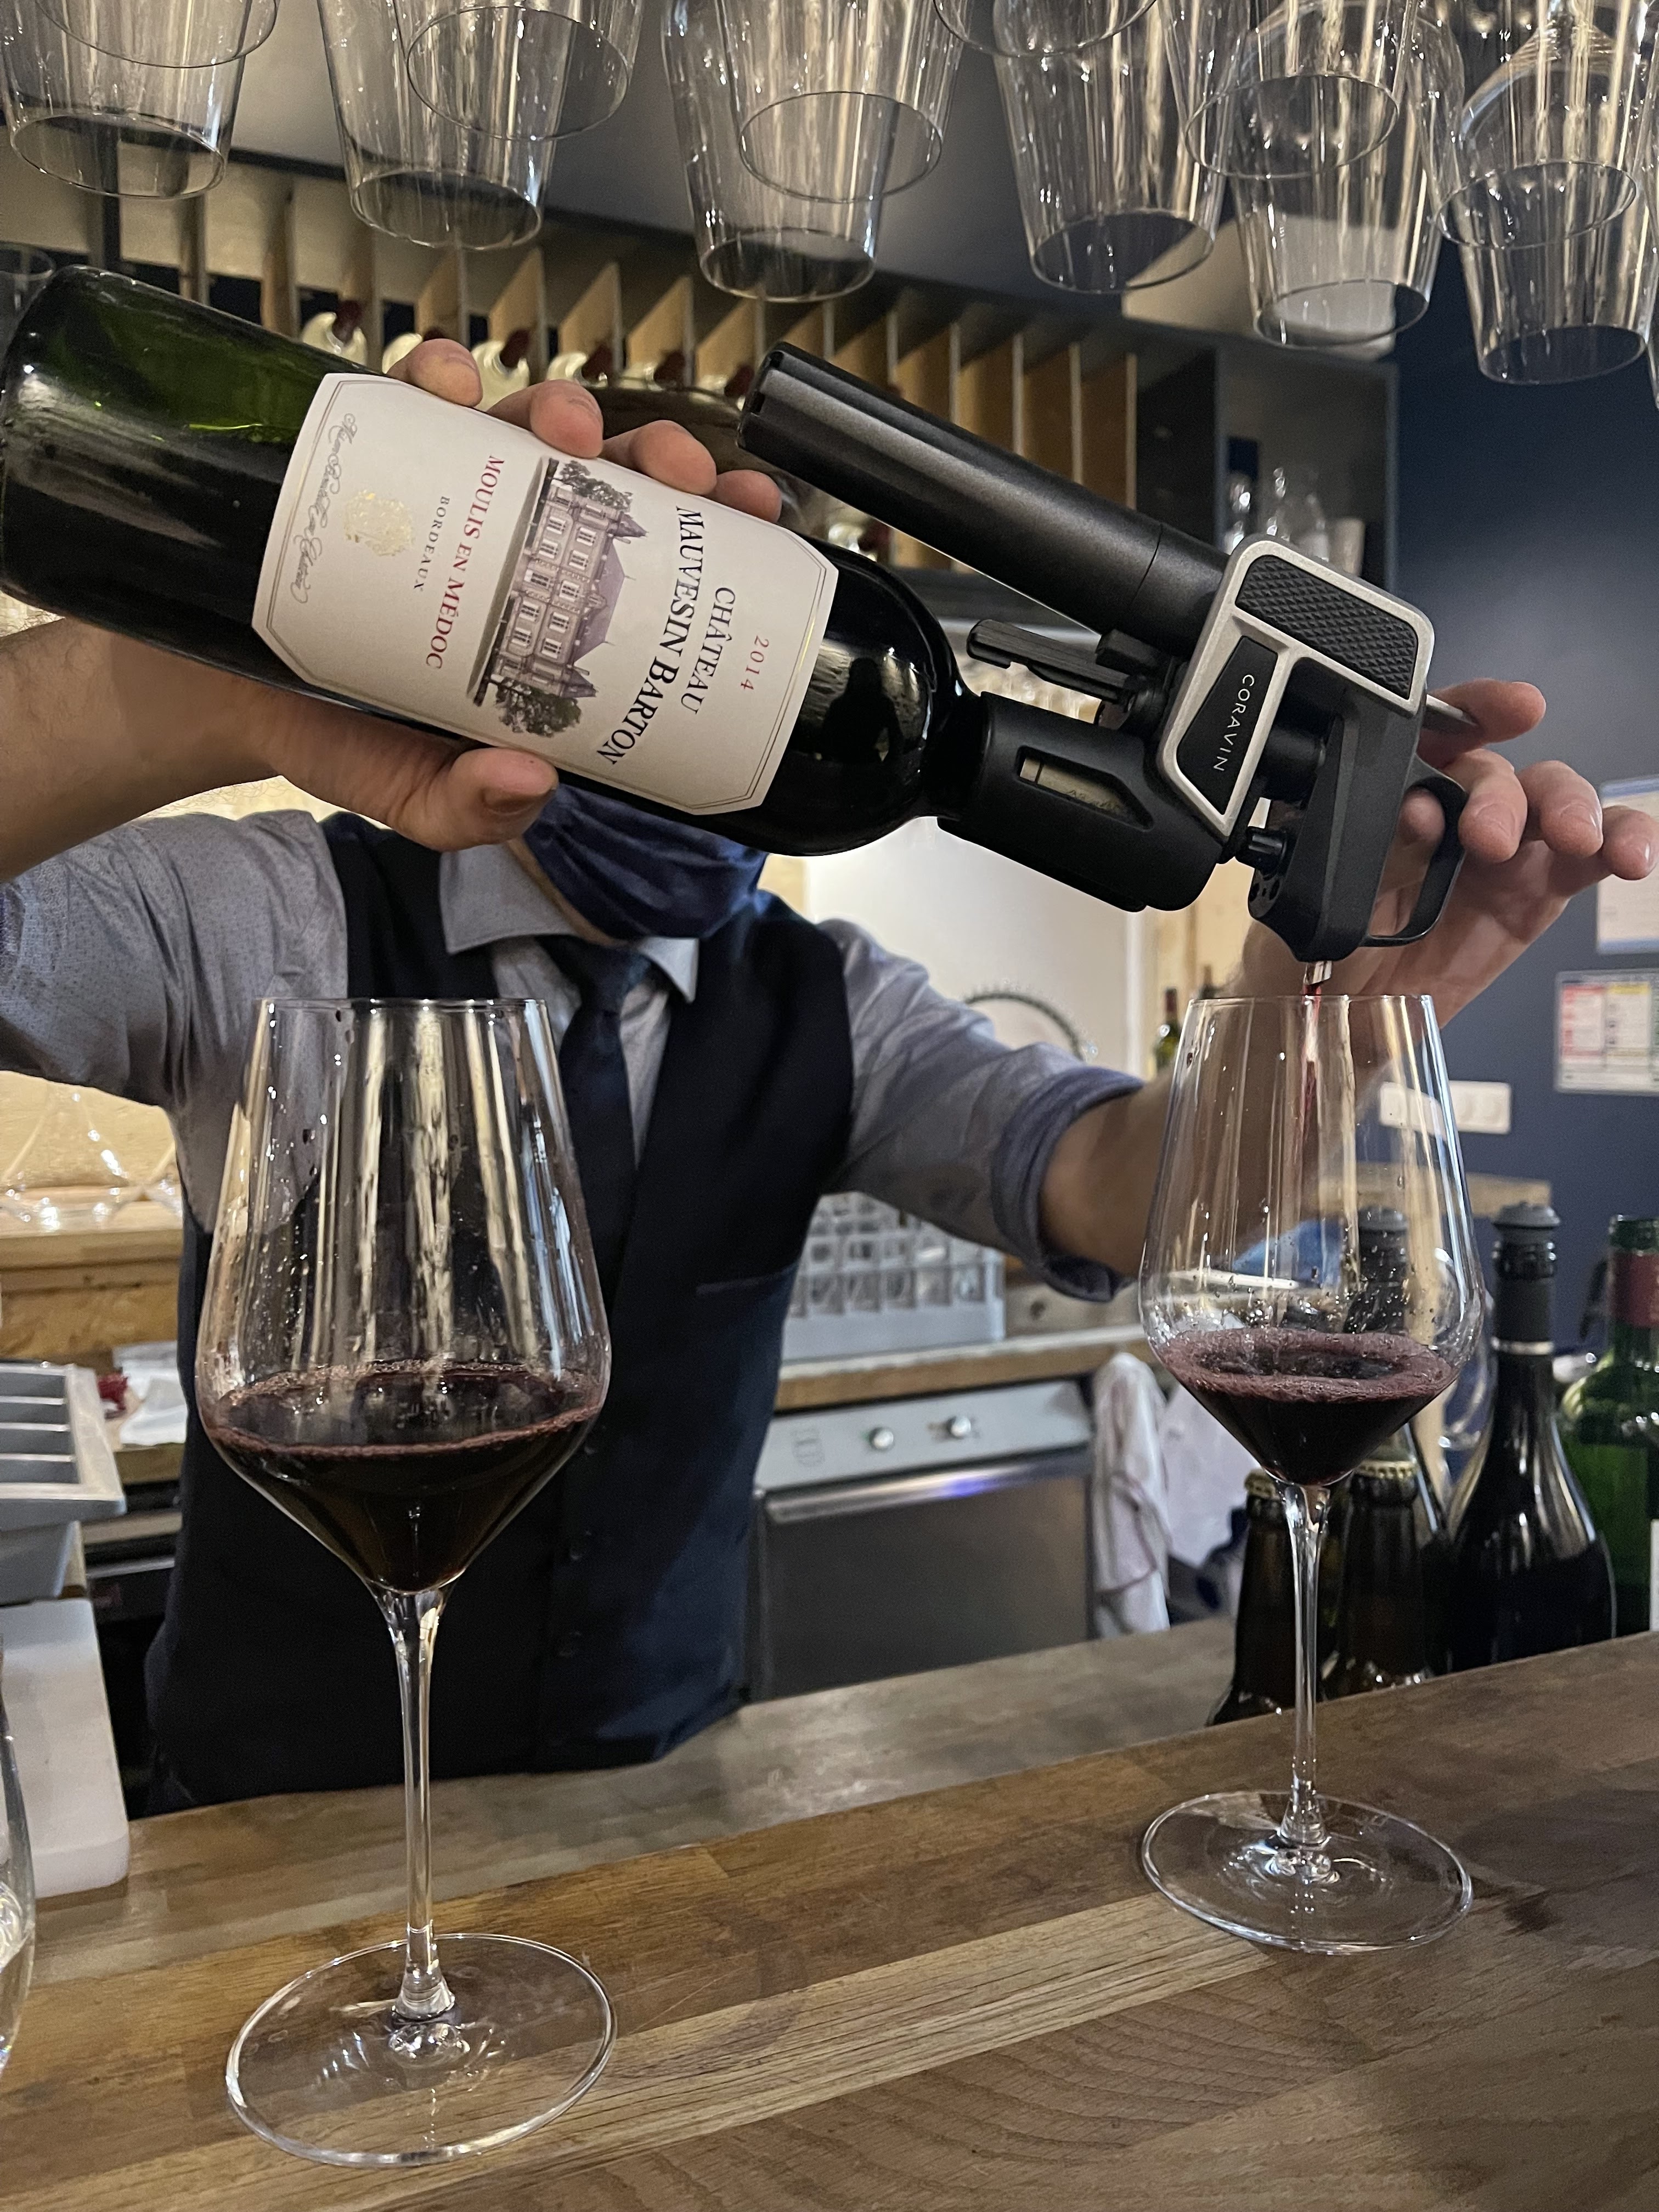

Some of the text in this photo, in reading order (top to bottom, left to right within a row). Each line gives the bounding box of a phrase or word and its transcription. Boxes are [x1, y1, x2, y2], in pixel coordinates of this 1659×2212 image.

[414, 496, 450, 592] BORDEAUX
[426, 456, 505, 669] MOULIS EN MÉDOC
[597, 505, 705, 765] MAUVESIN BARTON
[680, 587, 736, 714] CHÂTEAU
[741, 635, 769, 691] 2014
[1214, 674, 1255, 771] CORAVIN
